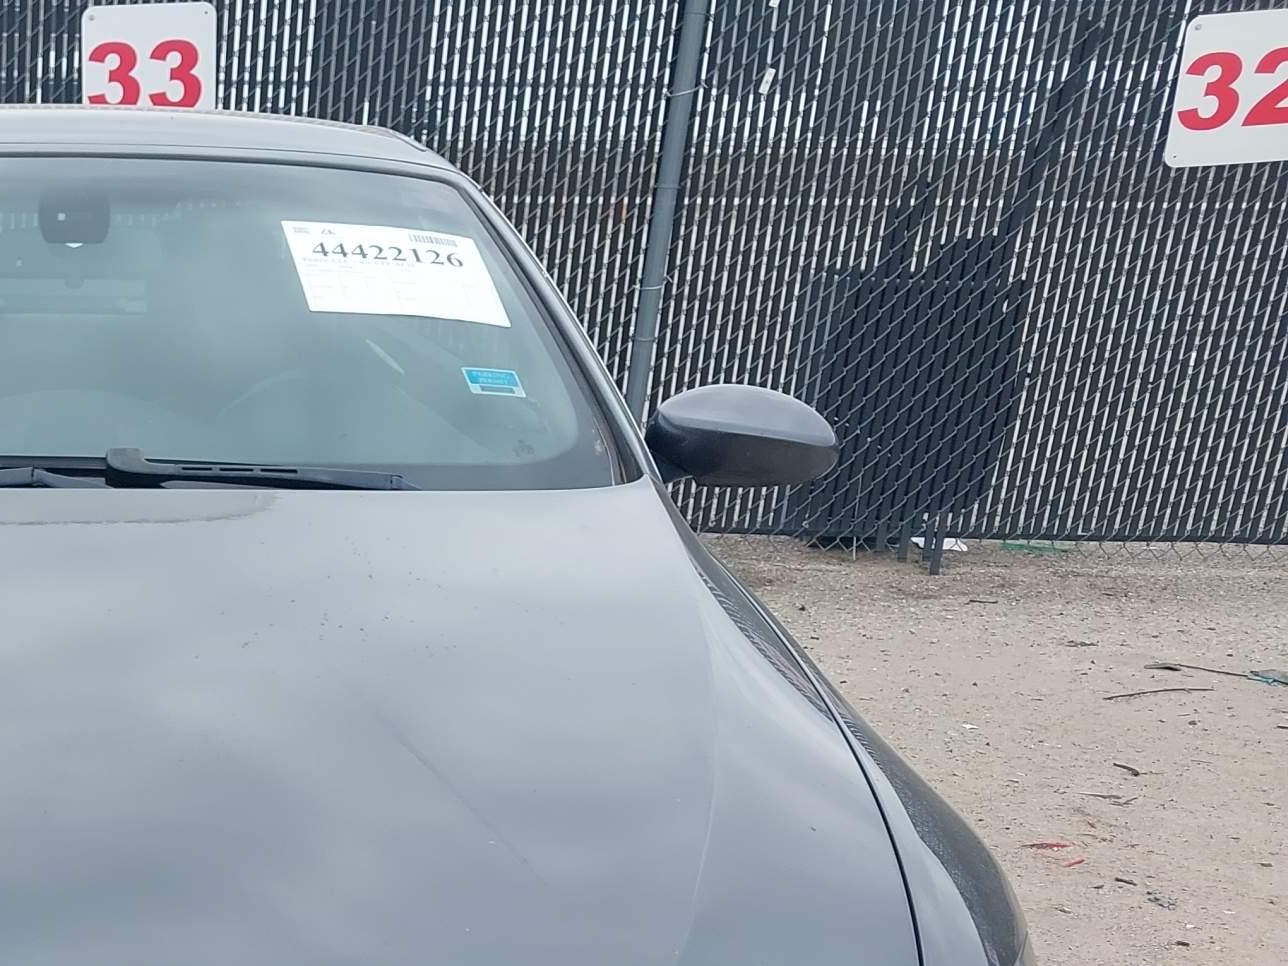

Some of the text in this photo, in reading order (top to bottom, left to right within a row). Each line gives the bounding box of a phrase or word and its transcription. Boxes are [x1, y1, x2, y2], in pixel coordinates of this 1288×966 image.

[87, 39, 202, 108] 33
[1177, 47, 1288, 131] 32
[313, 241, 464, 268] 44422126
